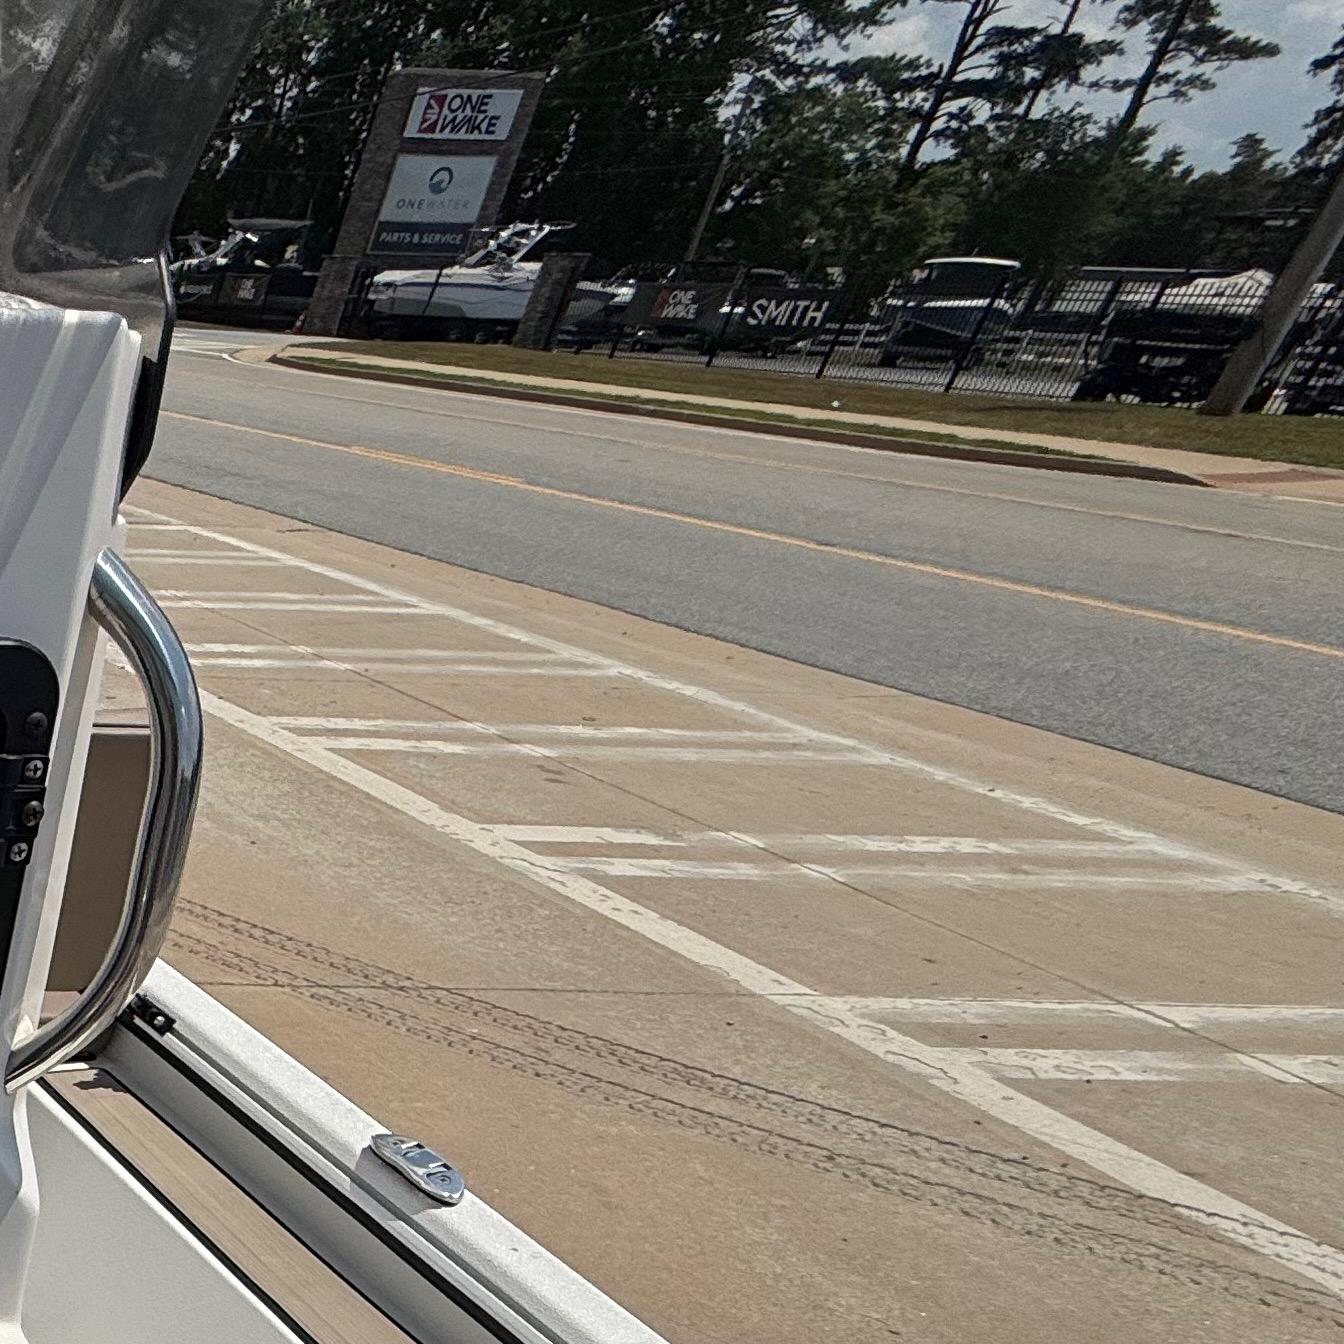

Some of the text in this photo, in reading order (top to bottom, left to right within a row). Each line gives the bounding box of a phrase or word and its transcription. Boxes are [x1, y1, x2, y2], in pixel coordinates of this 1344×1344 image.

[447, 94, 493, 114] ONE
[439, 115, 501, 135] WAKE
[379, 232, 410, 242] PARTS
[421, 233, 463, 244] SERVICE
[669, 290, 696, 303] ONE
[661, 303, 698, 319] WAKE
[747, 298, 829, 327] SMITH
